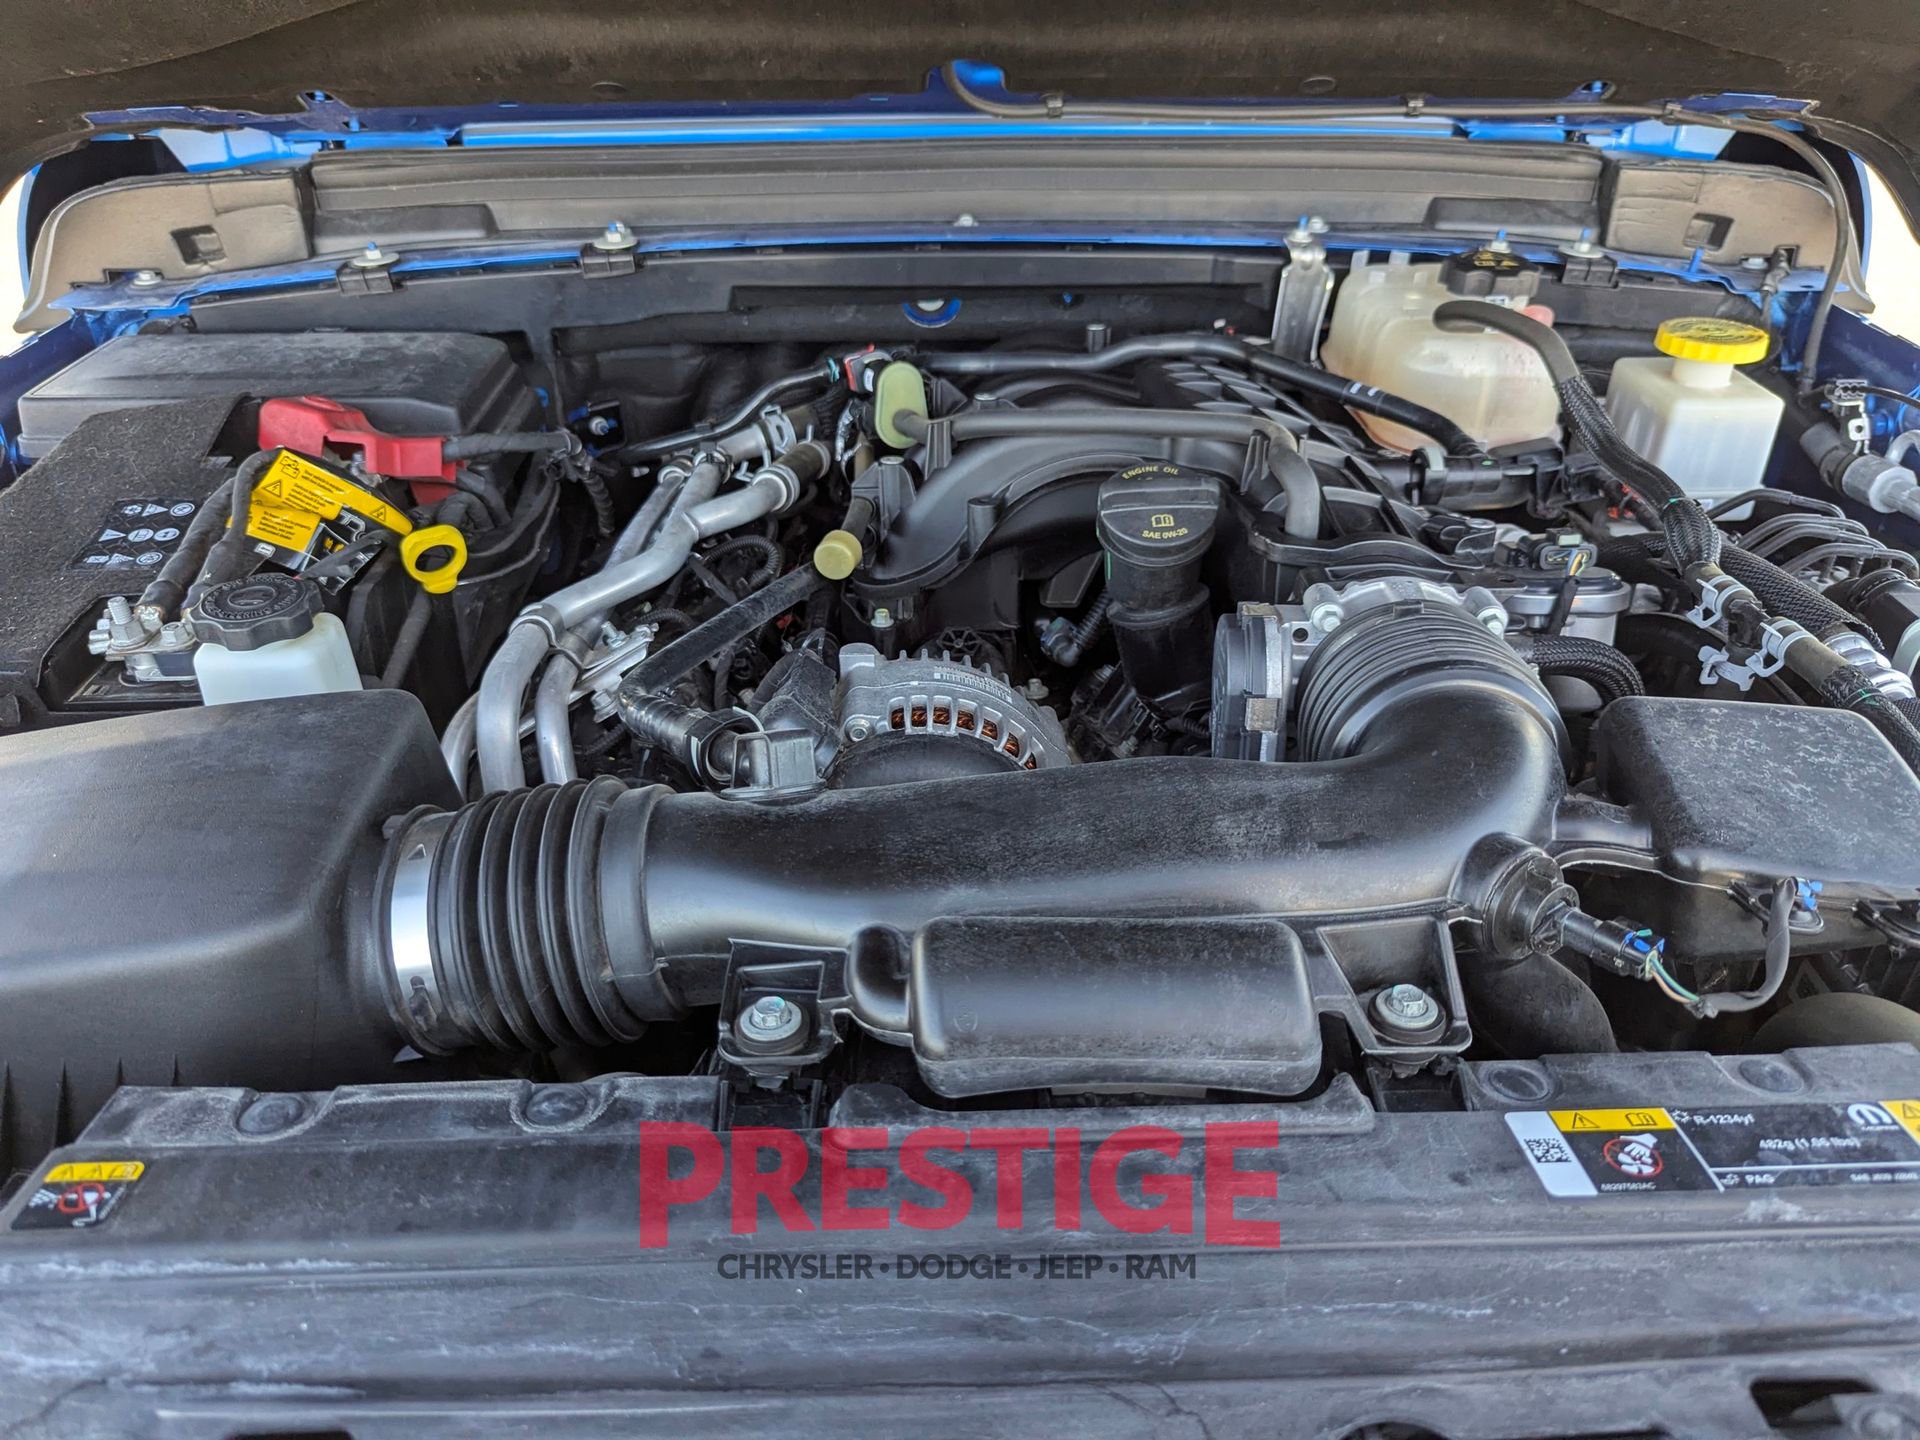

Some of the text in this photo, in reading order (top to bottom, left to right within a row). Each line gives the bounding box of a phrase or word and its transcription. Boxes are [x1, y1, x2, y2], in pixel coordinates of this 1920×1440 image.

[1121, 466, 1180, 480] ENGINE OIL
[1141, 527, 1188, 540] SAE 0W-20
